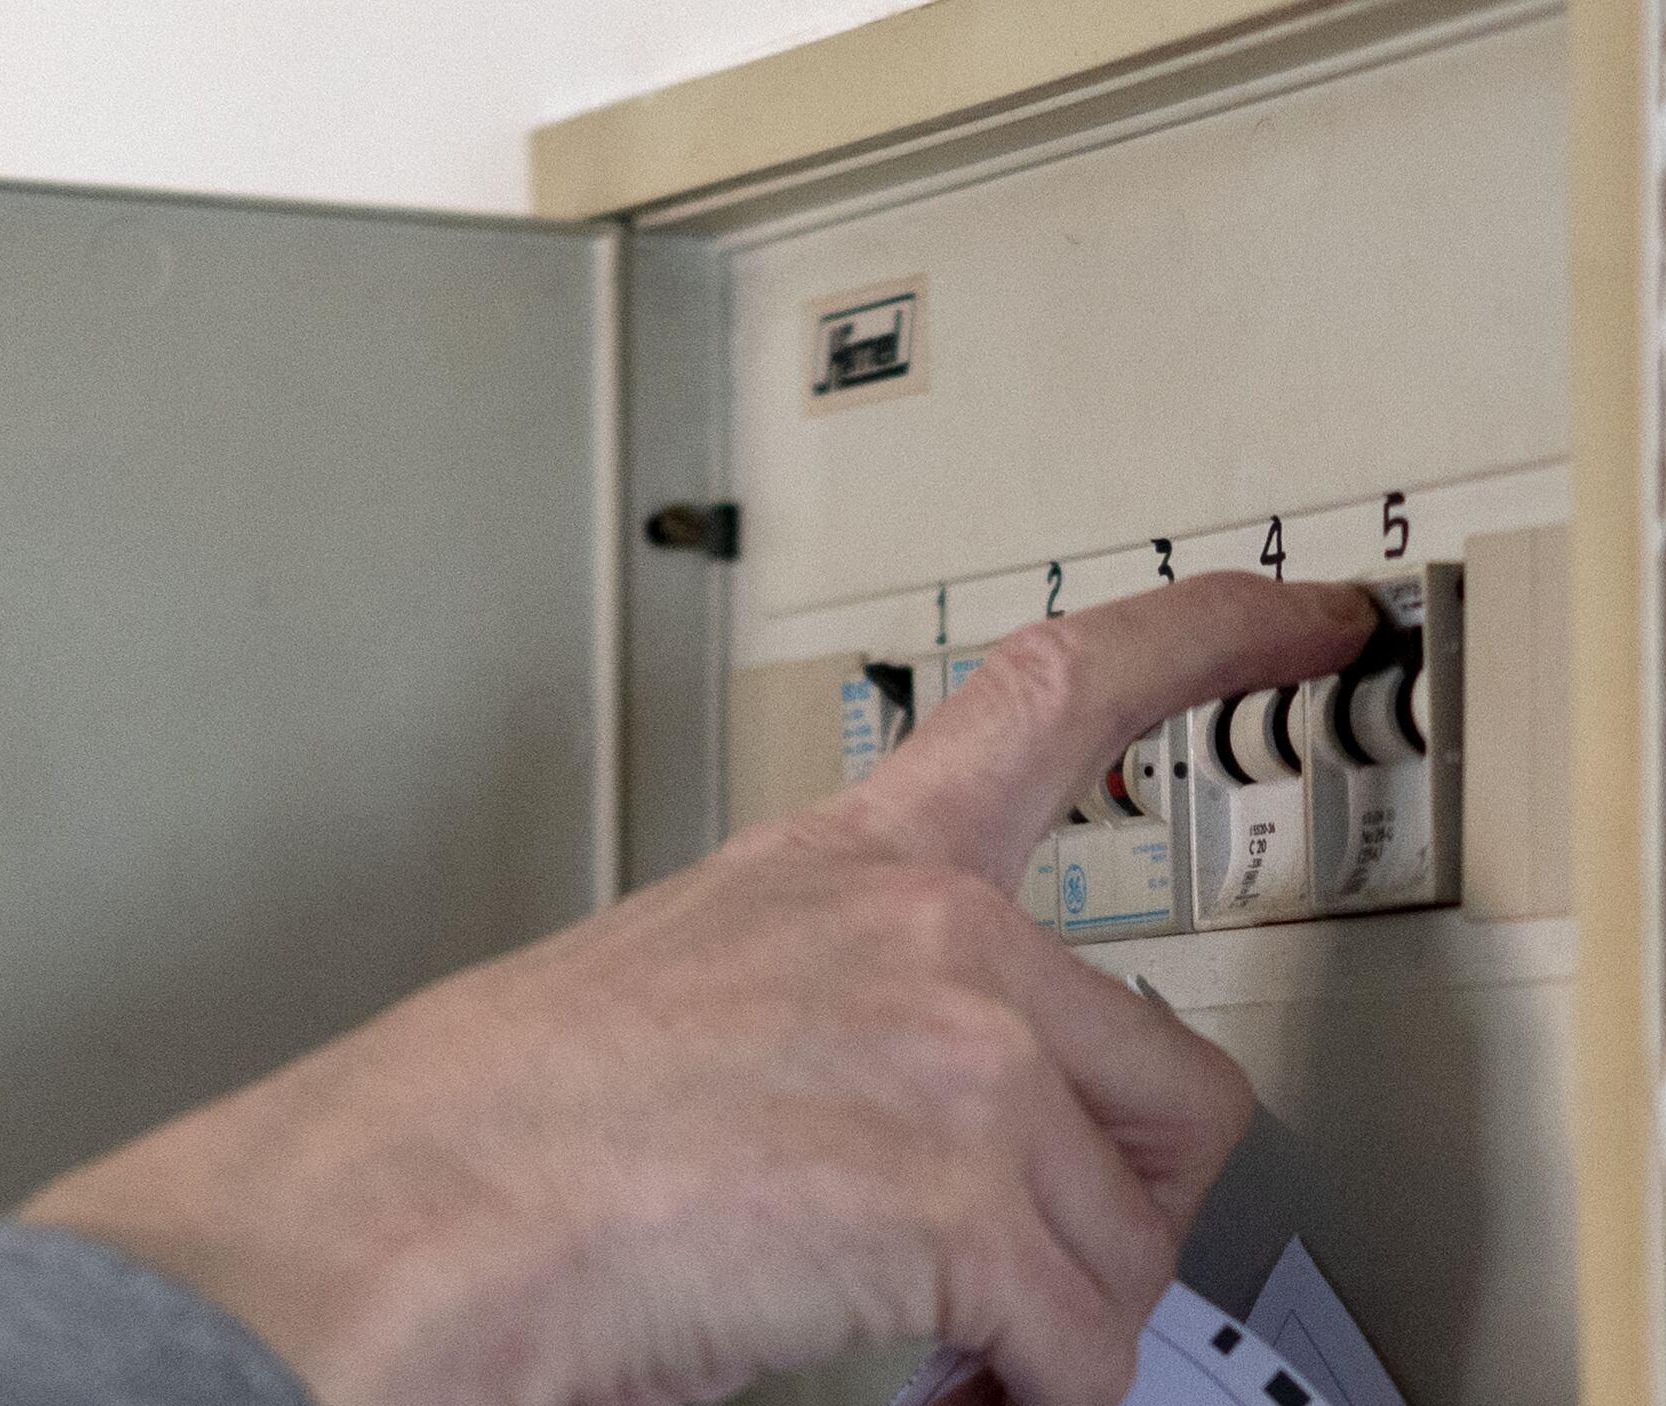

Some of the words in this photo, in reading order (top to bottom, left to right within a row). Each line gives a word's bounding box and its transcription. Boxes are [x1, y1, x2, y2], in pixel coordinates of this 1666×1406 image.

[1260, 515, 1286, 582] 4
[1381, 493, 1410, 559] 5
[1045, 562, 1065, 619] 2
[1151, 538, 1175, 584] 3
[934, 583, 947, 644] 1
[1256, 839, 1267, 854] 20
